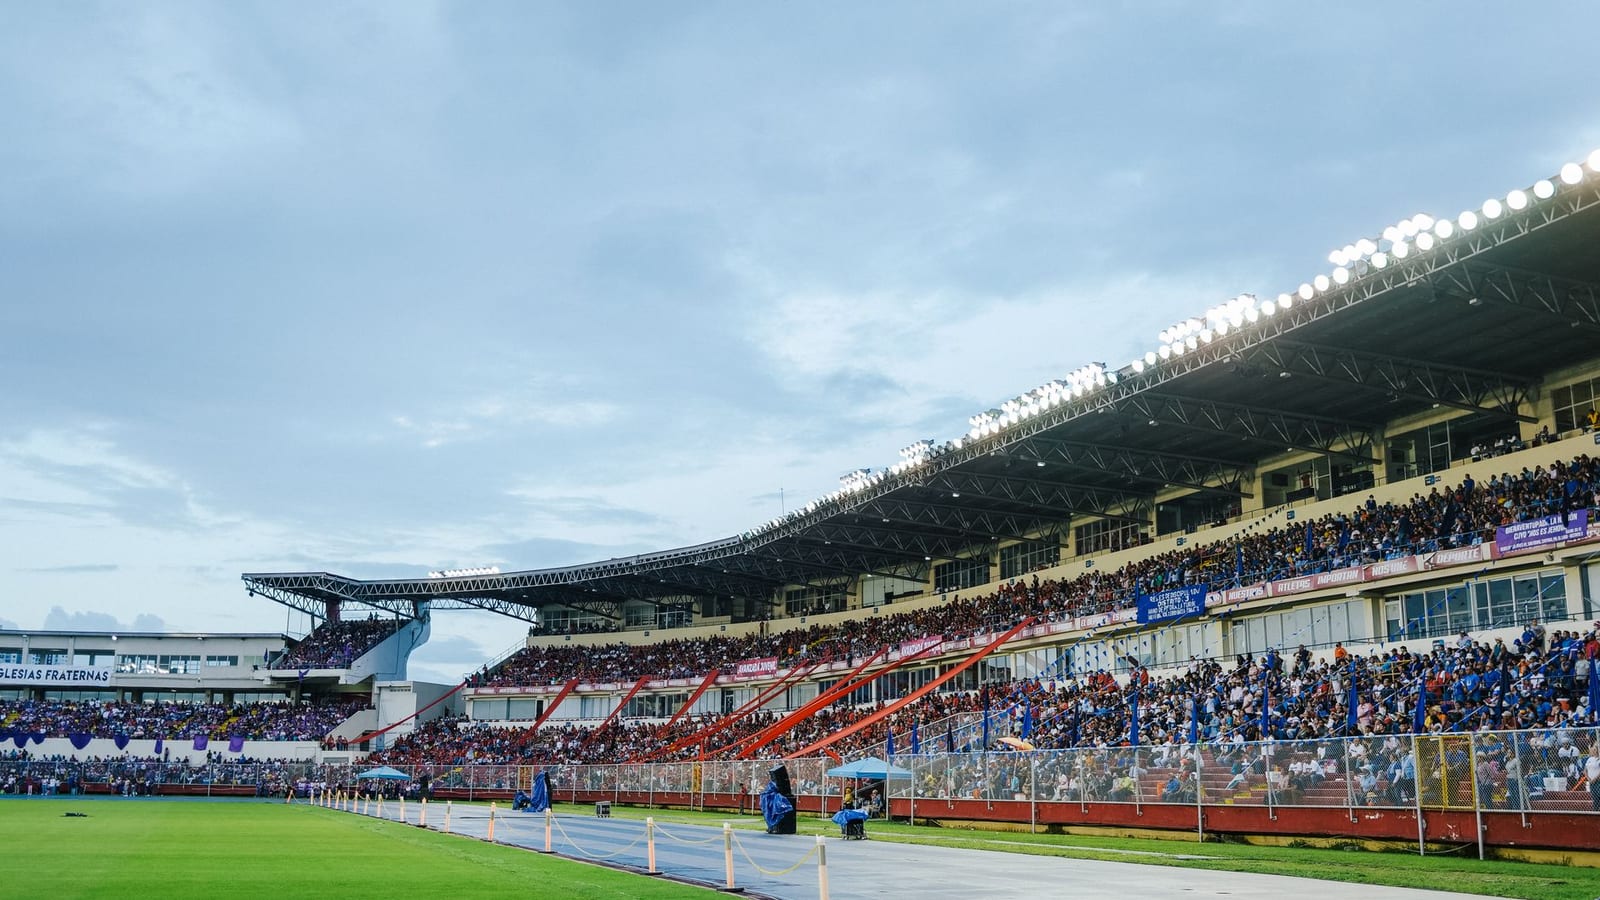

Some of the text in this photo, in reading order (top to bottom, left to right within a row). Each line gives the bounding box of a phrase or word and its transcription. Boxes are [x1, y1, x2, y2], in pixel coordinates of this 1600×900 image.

[1278, 579, 1311, 592] ATLETAS
[1317, 570, 1359, 584] IMPORTAN
[1372, 565, 1390, 577] NOS
[0, 668, 109, 682] GLESIAS FRATERNAS
